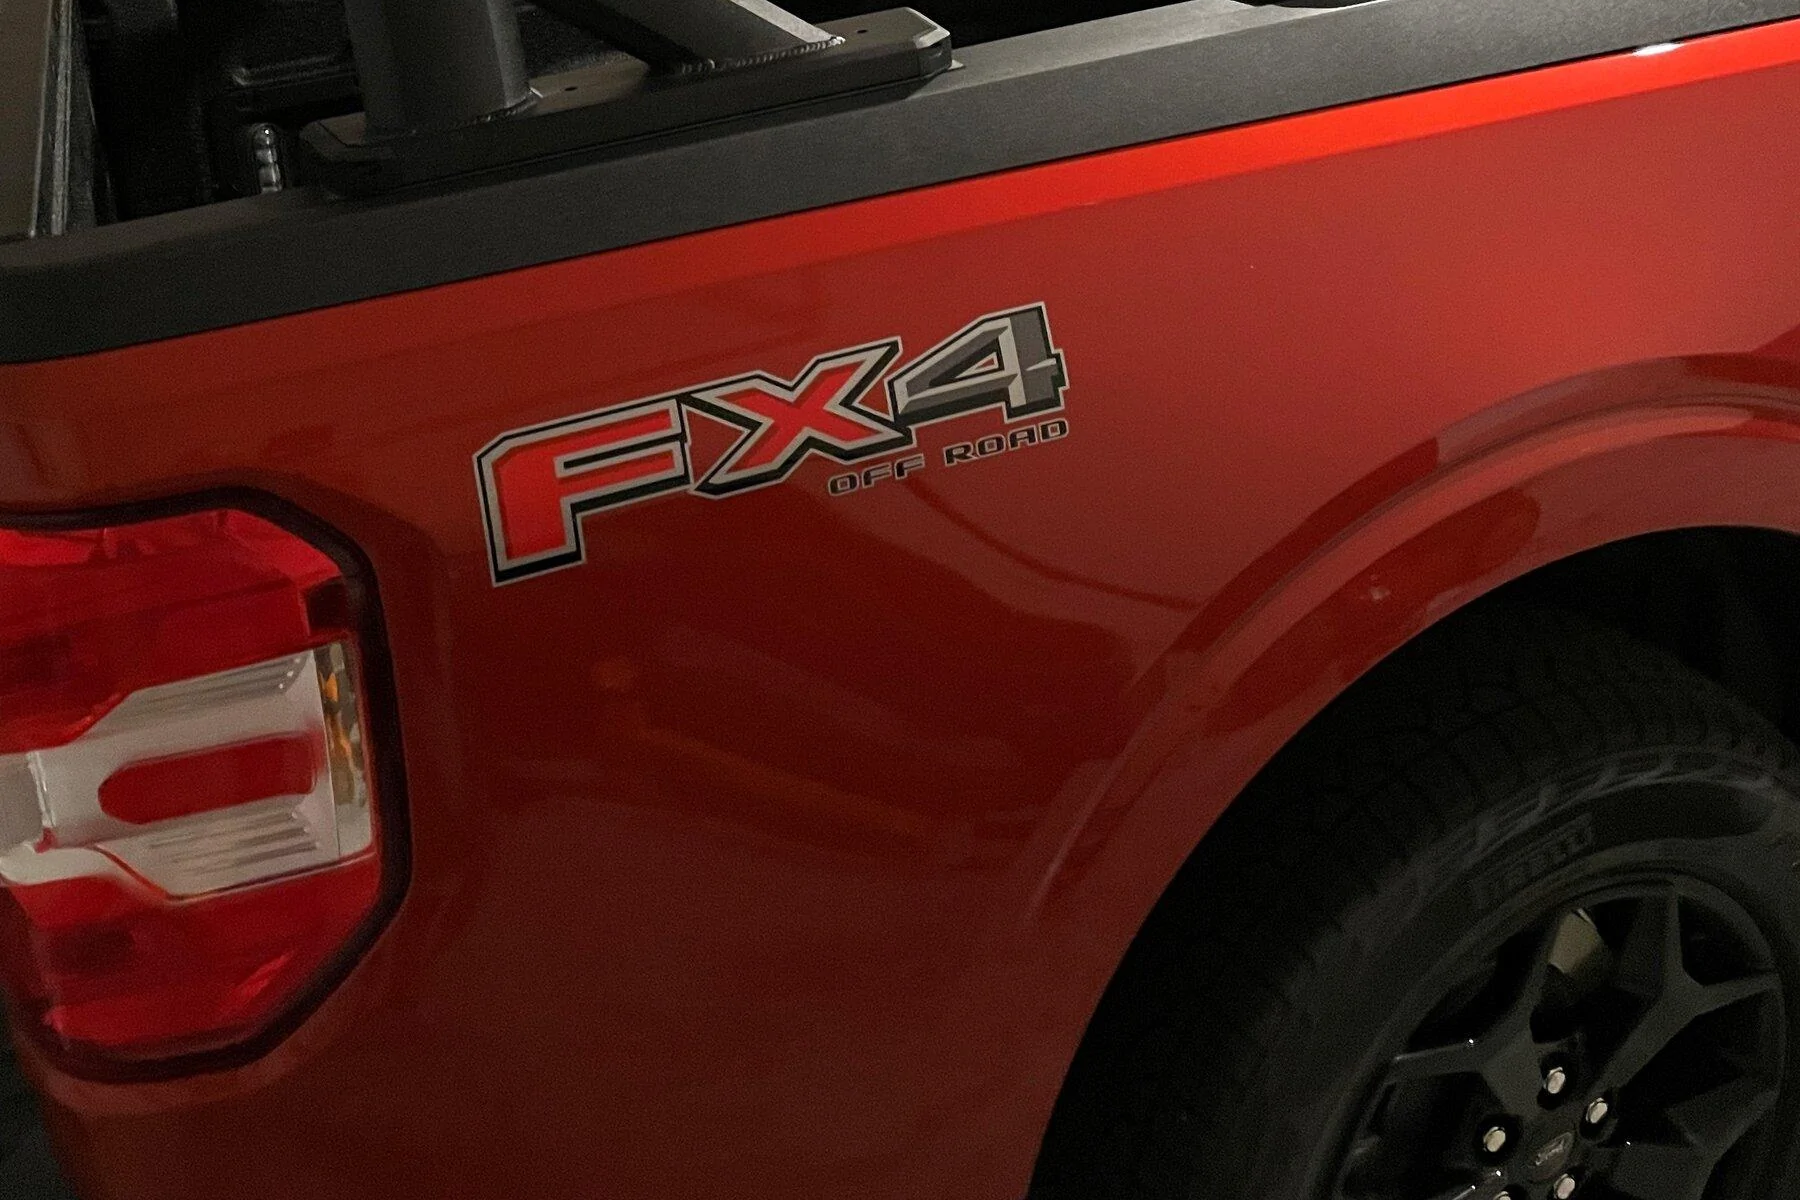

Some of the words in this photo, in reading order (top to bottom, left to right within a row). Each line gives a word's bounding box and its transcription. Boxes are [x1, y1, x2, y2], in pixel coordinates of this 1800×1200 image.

[473, 301, 1070, 587] FX4
[828, 453, 925, 496] OFF
[942, 417, 1069, 466] ROAD
